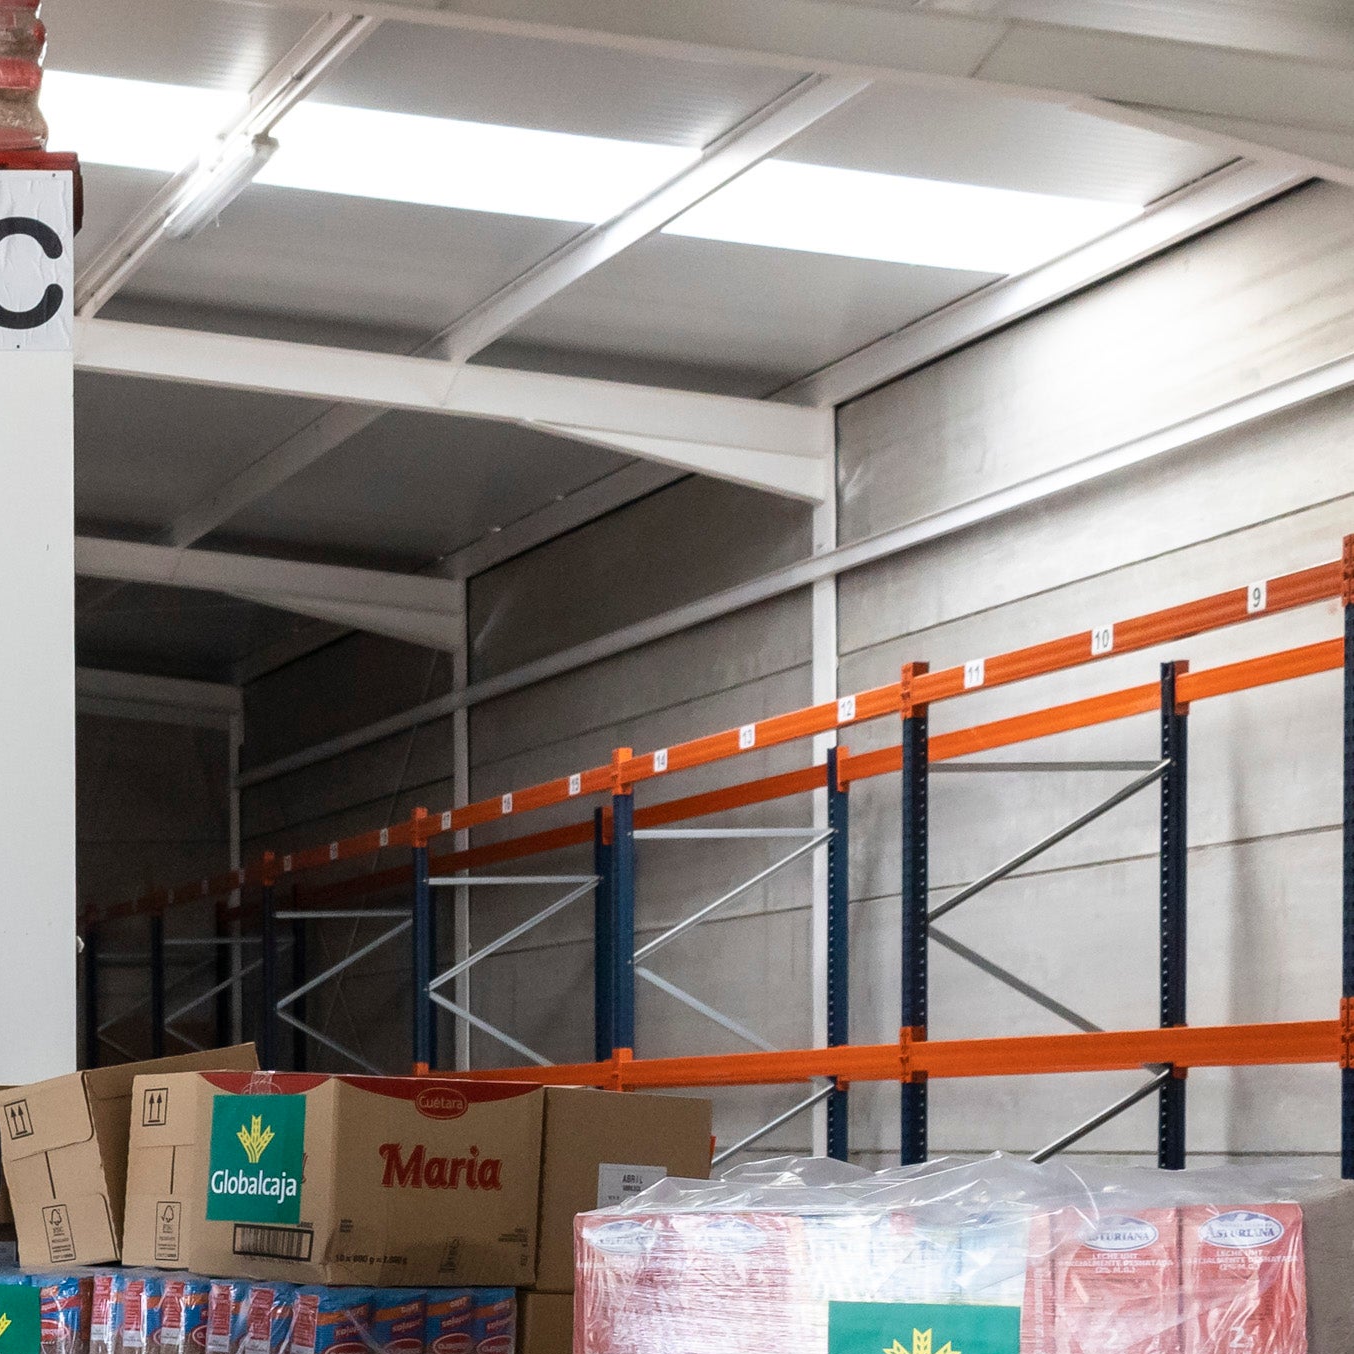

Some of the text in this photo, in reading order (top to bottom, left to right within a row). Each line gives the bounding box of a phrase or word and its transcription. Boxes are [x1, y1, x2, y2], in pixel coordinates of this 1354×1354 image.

[1253, 587, 1261, 608] 9
[1095, 629, 1110, 650] 10
[968, 665, 981, 683] 11
[841, 701, 853, 718] 12
[418, 1092, 465, 1112] Cuétara
[211, 1169, 297, 1204] Globalcaja
